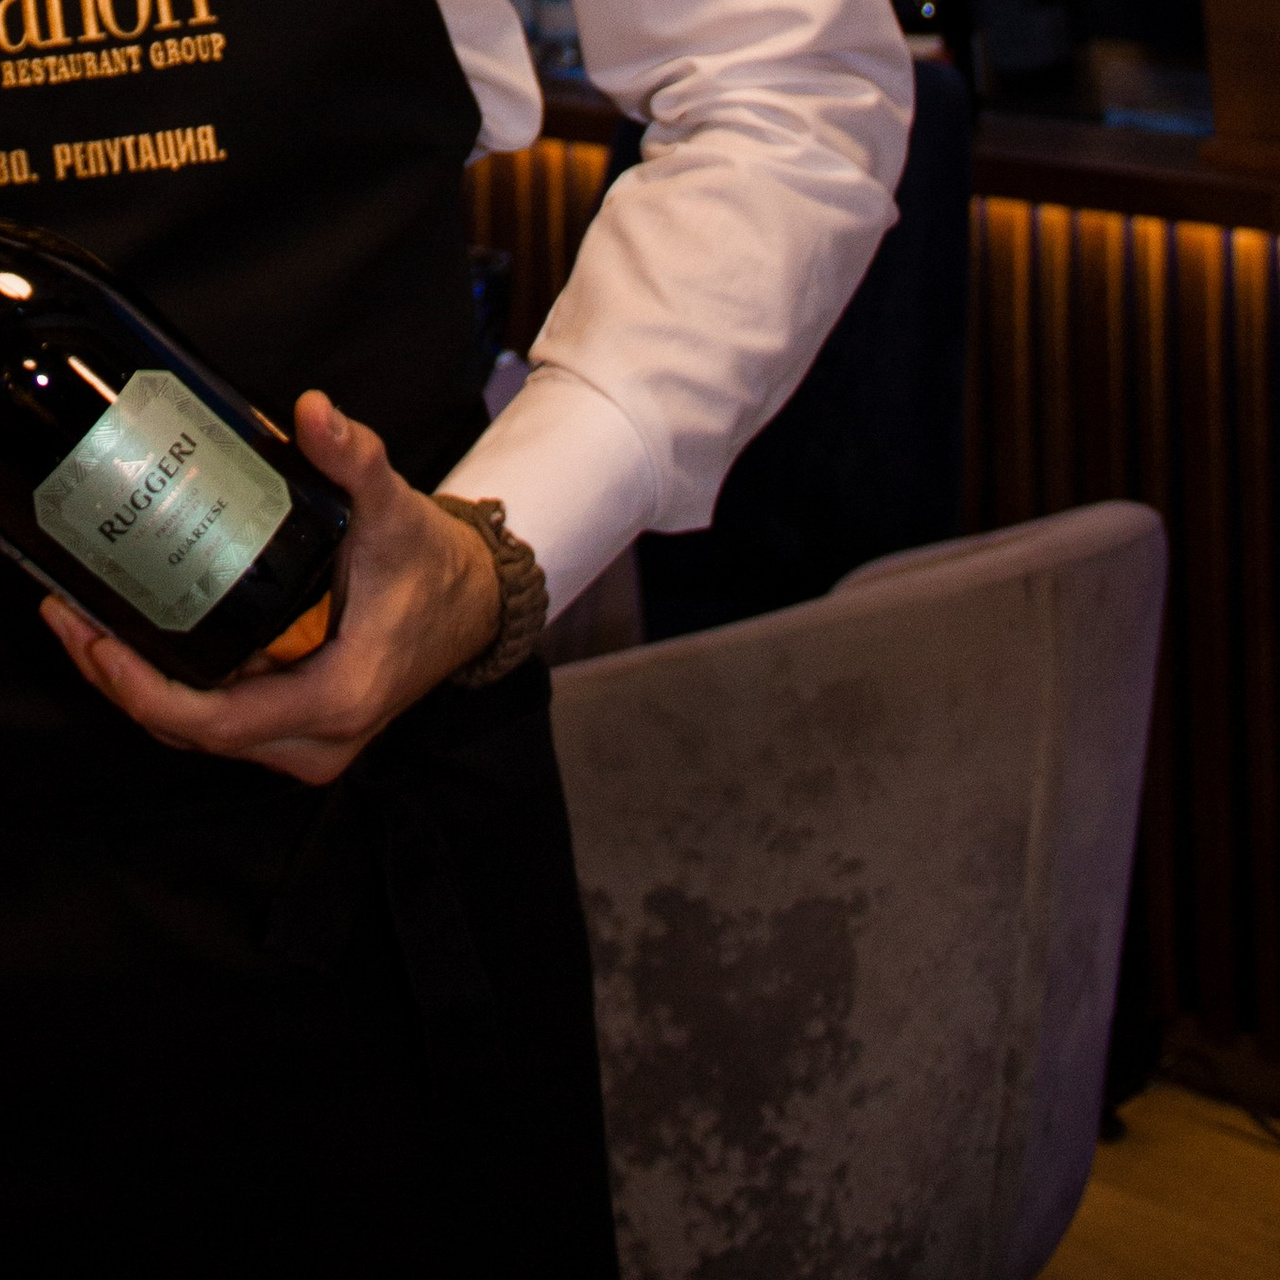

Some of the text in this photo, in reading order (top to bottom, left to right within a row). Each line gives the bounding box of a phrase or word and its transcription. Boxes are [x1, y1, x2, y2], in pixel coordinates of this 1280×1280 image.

[1, 33, 226, 88] RESTAURANT GROUP
[52, 124, 228, 181] РЕПУТАЦИЯ.
[97, 432, 197, 543] RUGGERI
[168, 496, 228, 565] QUARTESE
